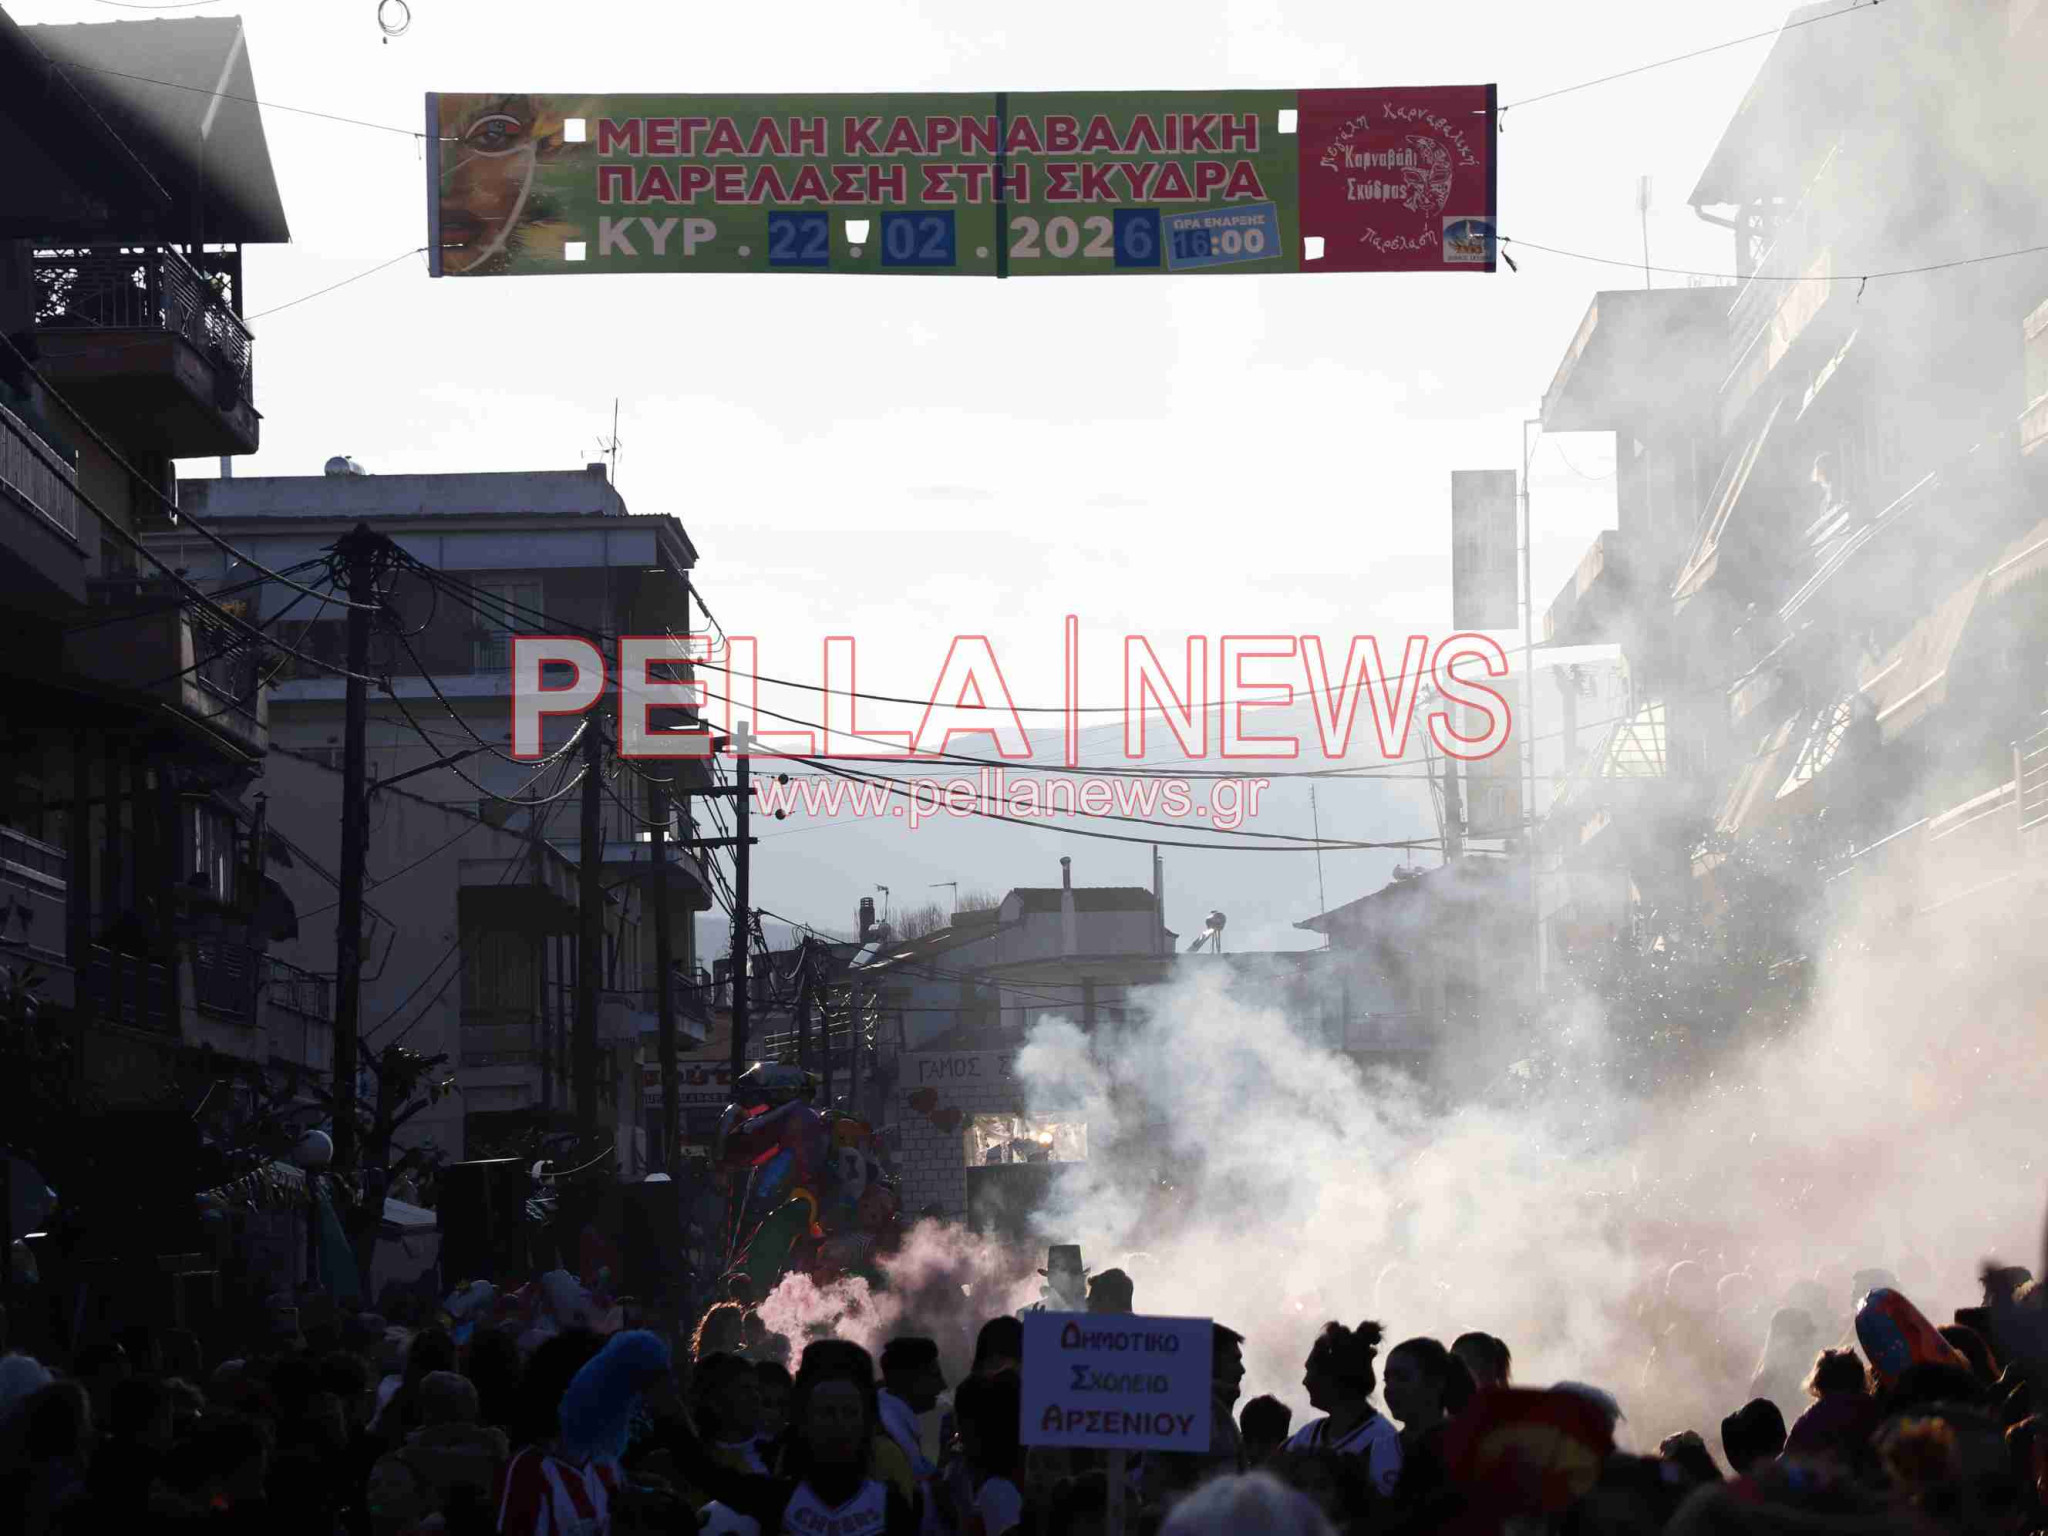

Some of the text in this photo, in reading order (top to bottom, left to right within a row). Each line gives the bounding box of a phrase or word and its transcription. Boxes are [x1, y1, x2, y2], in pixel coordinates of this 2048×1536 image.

[597, 113, 1260, 157] ΜΕΓΑΛΗ ΚΑΡΝΑΒΑΛΙΚΗ
[597, 161, 1268, 204] ΠΑΡΕΛΑΣΗ ΣΤΗ ΣΚΥΔΡΑ
[769, 219, 826, 259] 22
[886, 218, 949, 259] 02
[1009, 216, 1153, 259] 2026
[1173, 219, 1201, 230] ΩΡΑ
[1174, 229, 1265, 261] 16:00
[918, 1057, 981, 1083] ΓΑΜΟΣ
[1060, 1320, 1180, 1352] ΔΗΜΟΤΙΚΟ
[1041, 1404, 1196, 1437] ΑΡΣΕΝΙΟΥ
